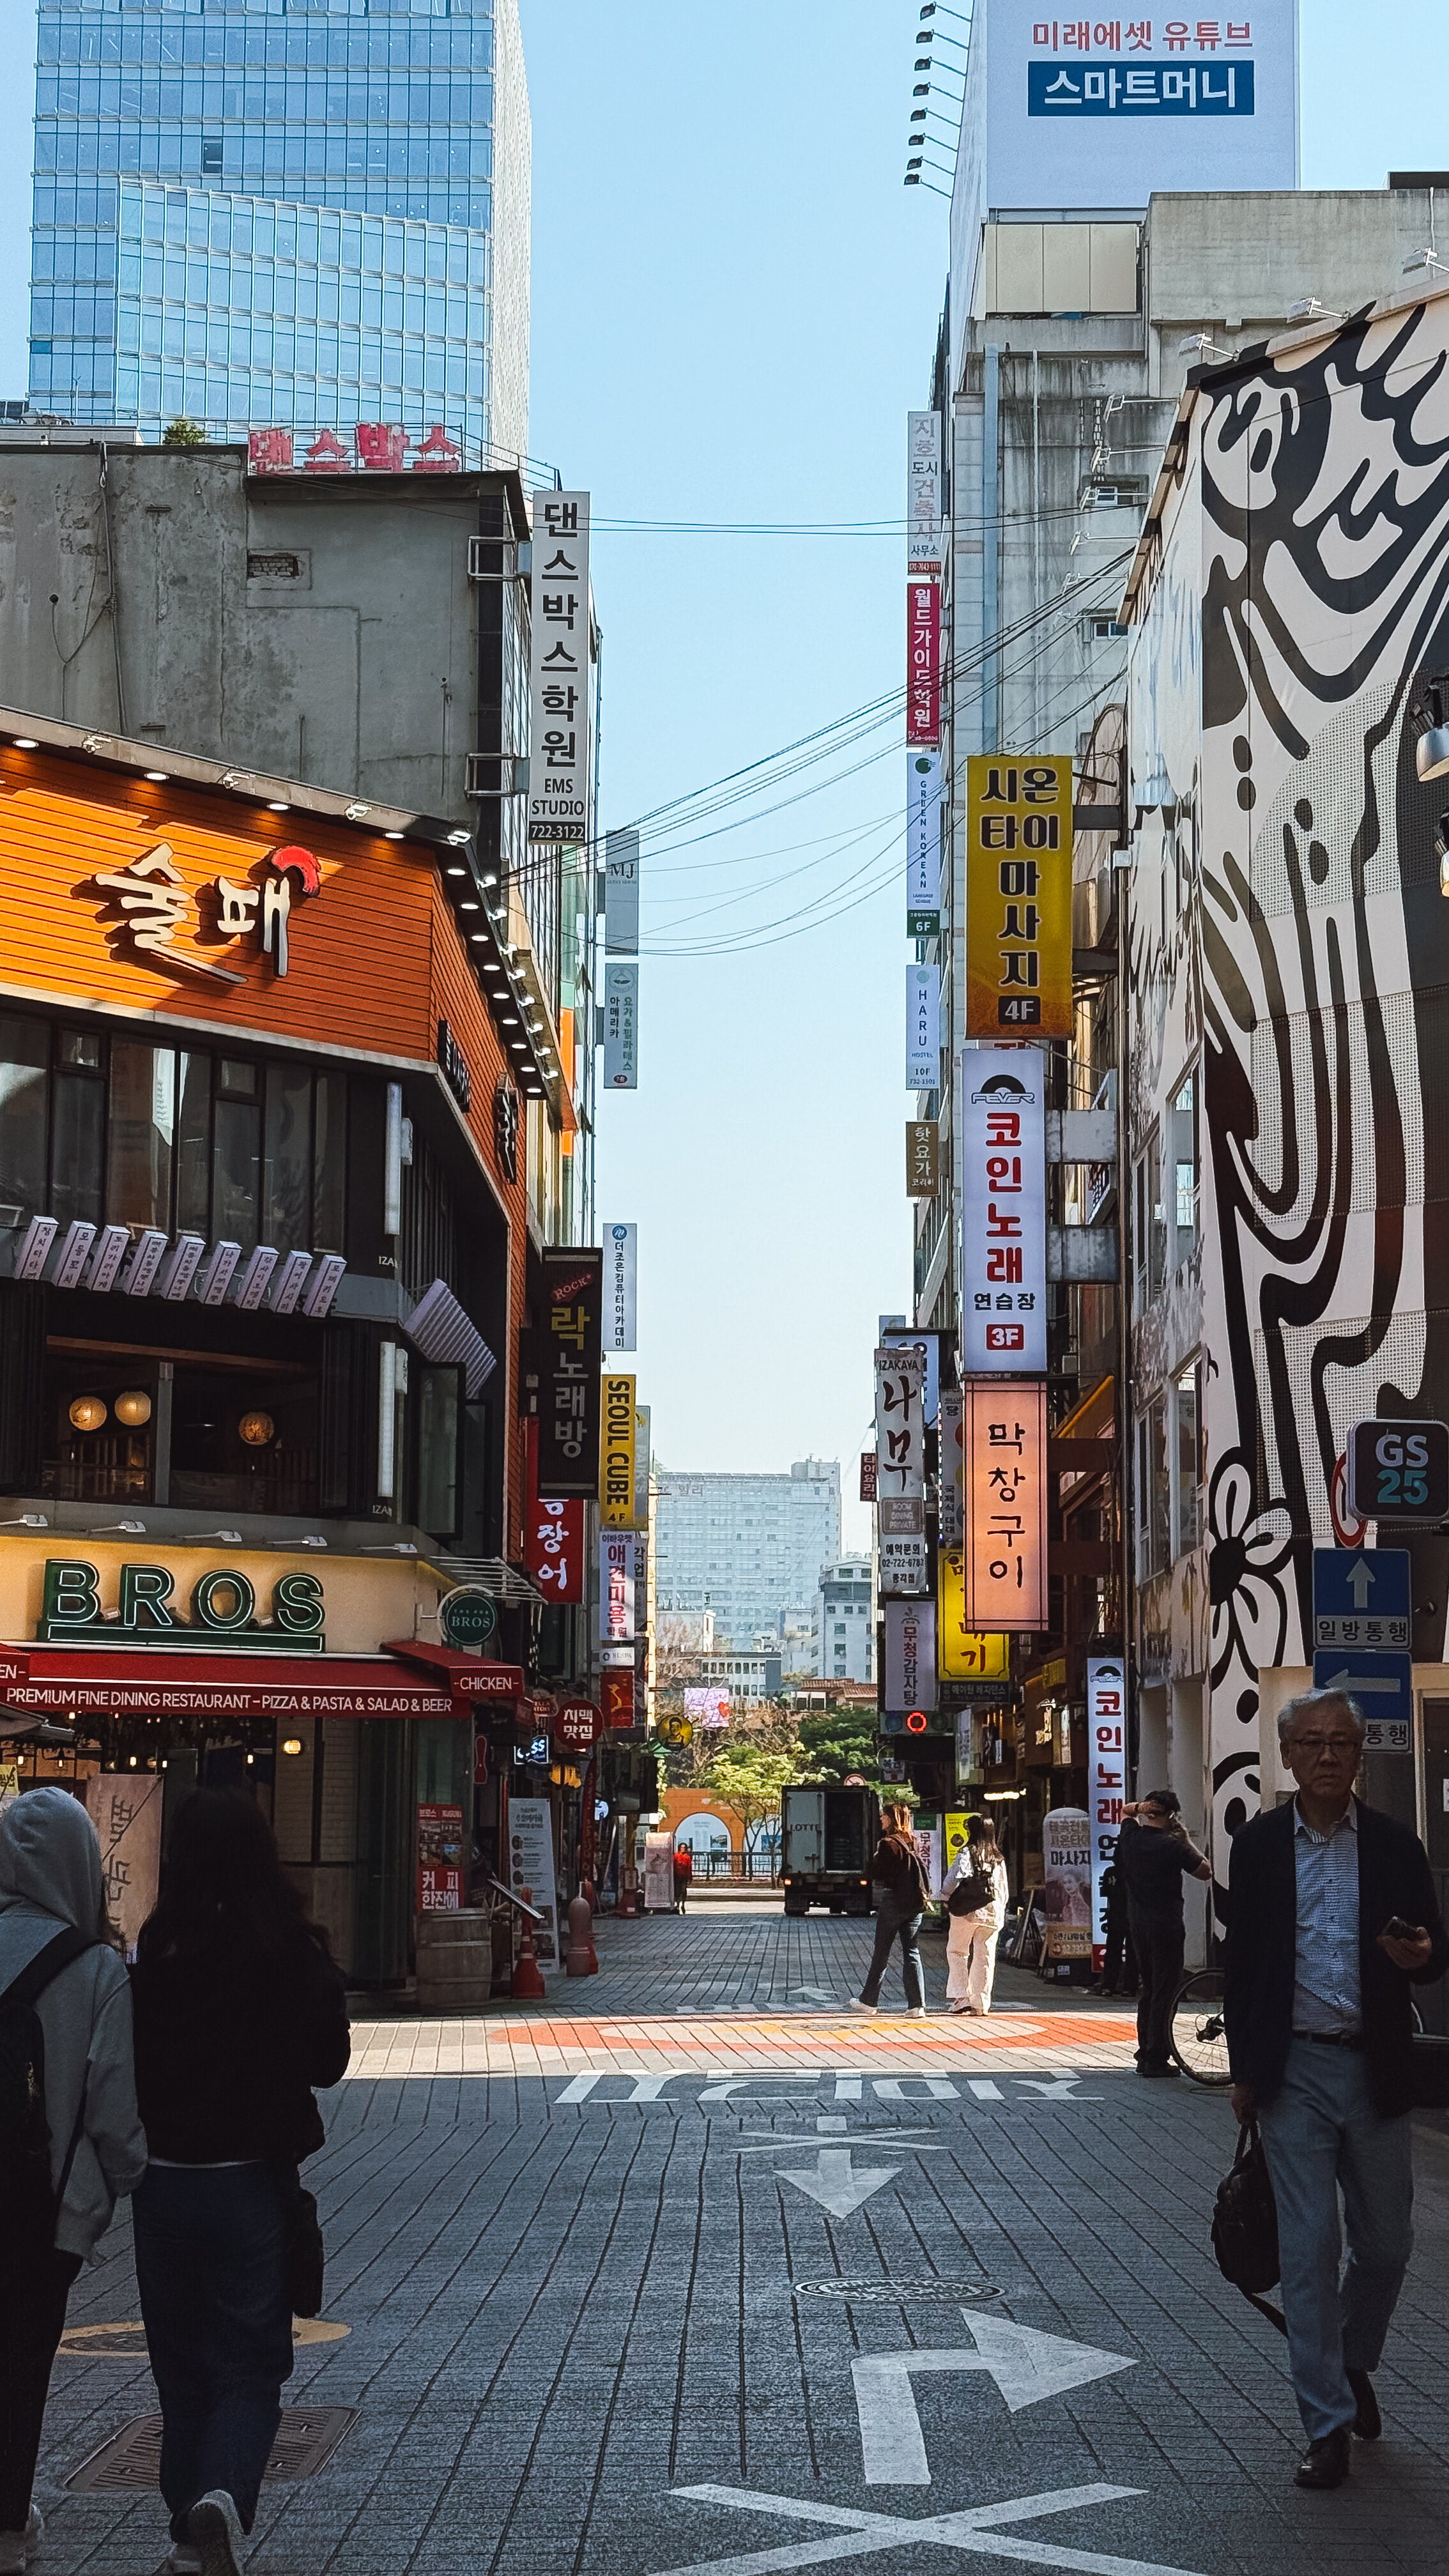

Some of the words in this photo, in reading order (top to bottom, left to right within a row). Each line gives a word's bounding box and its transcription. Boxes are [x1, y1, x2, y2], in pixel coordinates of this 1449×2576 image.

[1032, 20, 1153, 52] 미래에셋
[1162, 21, 1254, 51] 유튜브
[1044, 67, 1236, 109] 스마트머니
[912, 461, 938, 476] 도시
[910, 544, 939, 556] 사무소
[540, 502, 579, 768] 댄스박스학원
[914, 588, 933, 728] 월드가이드학원
[544, 778, 573, 794] EMS
[980, 767, 1060, 804] 시온
[532, 799, 585, 817] STUDIO
[531, 825, 585, 841] 722-3122
[980, 814, 1059, 850] 타이
[611, 863, 635, 880] MJ
[916, 921, 931, 931] 6F
[997, 860, 1041, 988] 마사지
[610, 996, 620, 1039] 아메리카
[918, 989, 928, 1046] HARU
[1004, 1000, 1034, 1021] 4F
[971, 1091, 1036, 1104] FEVER
[914, 1126, 931, 1176] 핫요가
[985, 1112, 1023, 1284] 코인노래
[554, 1278, 588, 1301] ROCK
[615, 1241, 625, 1348] 더조은컴퓨터아카데미
[974, 1292, 1036, 1311] 연습장
[991, 1328, 1019, 1346] 3F
[879, 1359, 919, 1371] IZAKAYA
[608, 1380, 630, 1446] SEOUL
[883, 1375, 917, 1492] 나무
[1375, 1434, 1429, 1468] GS
[606, 1456, 629, 1506] CUBE
[1377, 1470, 1429, 1505] 25
[608, 1512, 625, 1522] 4F
[986, 1422, 1026, 1589] 막창구이
[885, 1543, 920, 1556] 예약문의
[45, 1558, 326, 1632] BROS
[607, 1544, 627, 1624] 애견미용
[451, 1616, 491, 1628] BROS
[1318, 1620, 1407, 1643] 일방통행
[903, 1627, 919, 1706] 무청감자탕
[459, 1676, 512, 1690] CHICKEN
[6, 1687, 76, 1705] PREMIUM
[78, 1690, 109, 1706] FINE
[111, 1691, 160, 1707] DINING
[163, 1692, 252, 1709] RESTAURANT
[262, 1695, 299, 1710] PIZZA
[300, 1696, 312, 1710] &
[313, 1696, 353, 1710] PASTA
[355, 1697, 365, 1710] &
[367, 1697, 409, 1712] SALAD
[411, 1698, 420, 1712] &
[422, 1698, 452, 1712] BEER
[564, 1709, 593, 1723] 치맥
[564, 1725, 593, 1740] 맛집
[1095, 1690, 1124, 1825] 코인노래
[790, 1823, 821, 1832] LOTTE
[1050, 1850, 1091, 1866] 마사지
